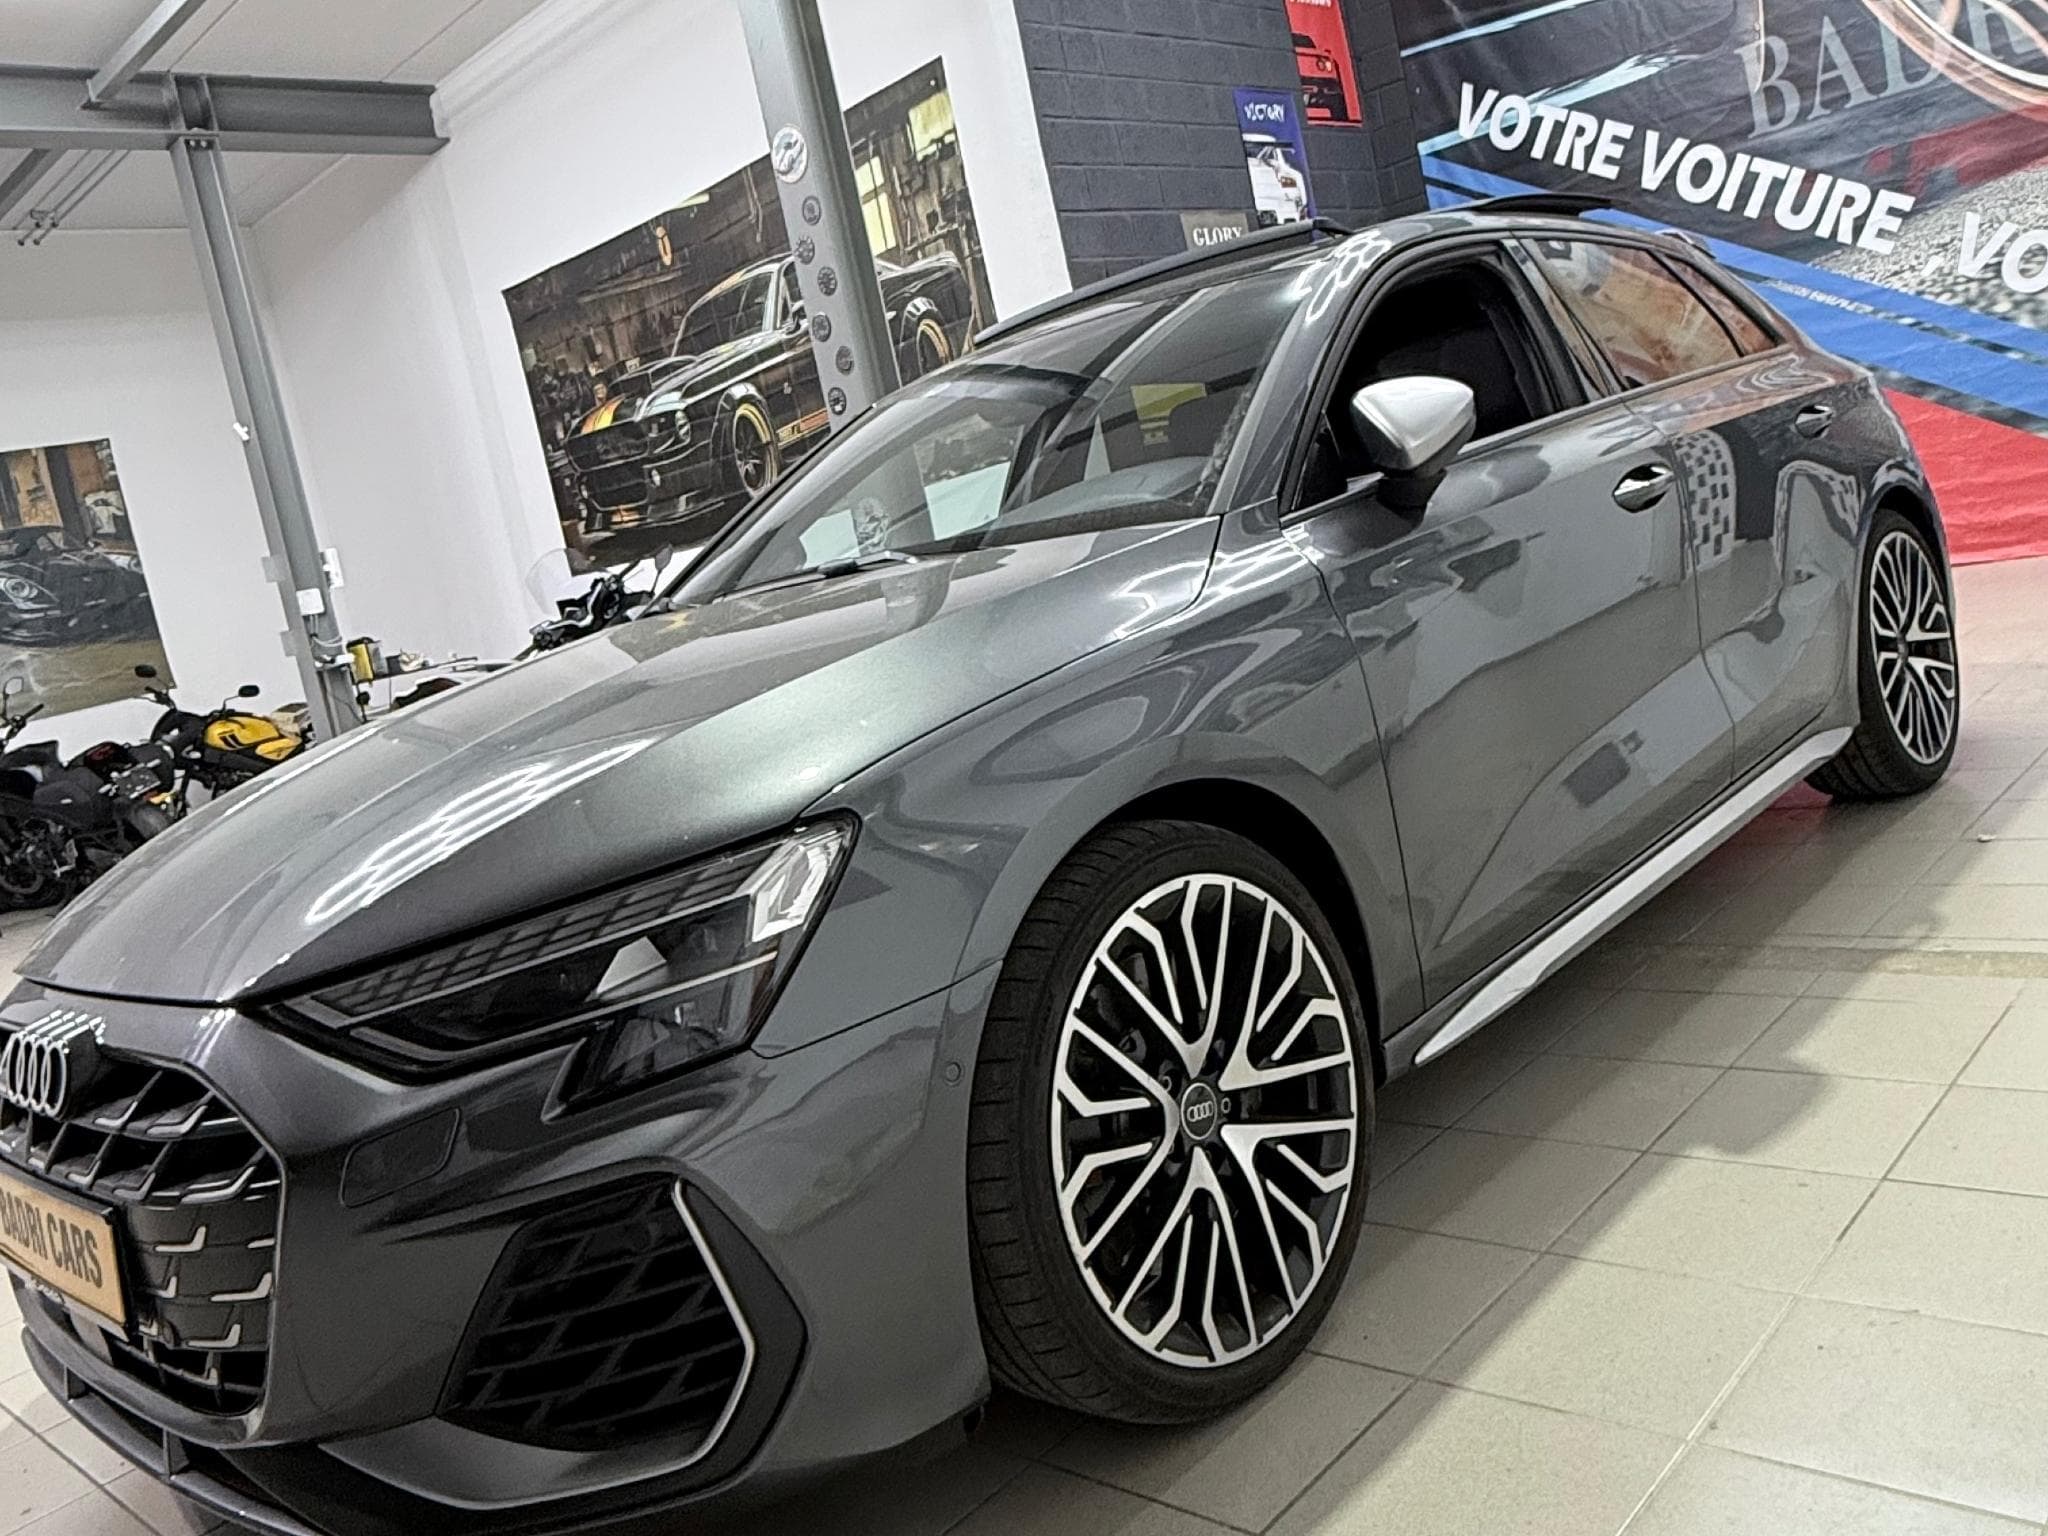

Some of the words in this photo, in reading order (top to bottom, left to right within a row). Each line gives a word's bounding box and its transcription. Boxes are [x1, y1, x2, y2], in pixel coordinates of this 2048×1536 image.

[1243, 101, 1285, 123] VICTORY
[1457, 81, 1635, 181] VOTRE
[1640, 129, 1916, 255] VOITURE
[1957, 210, 2048, 294] VO
[1192, 226, 1243, 247] GLORY
[46, 1211, 103, 1289] CARS
